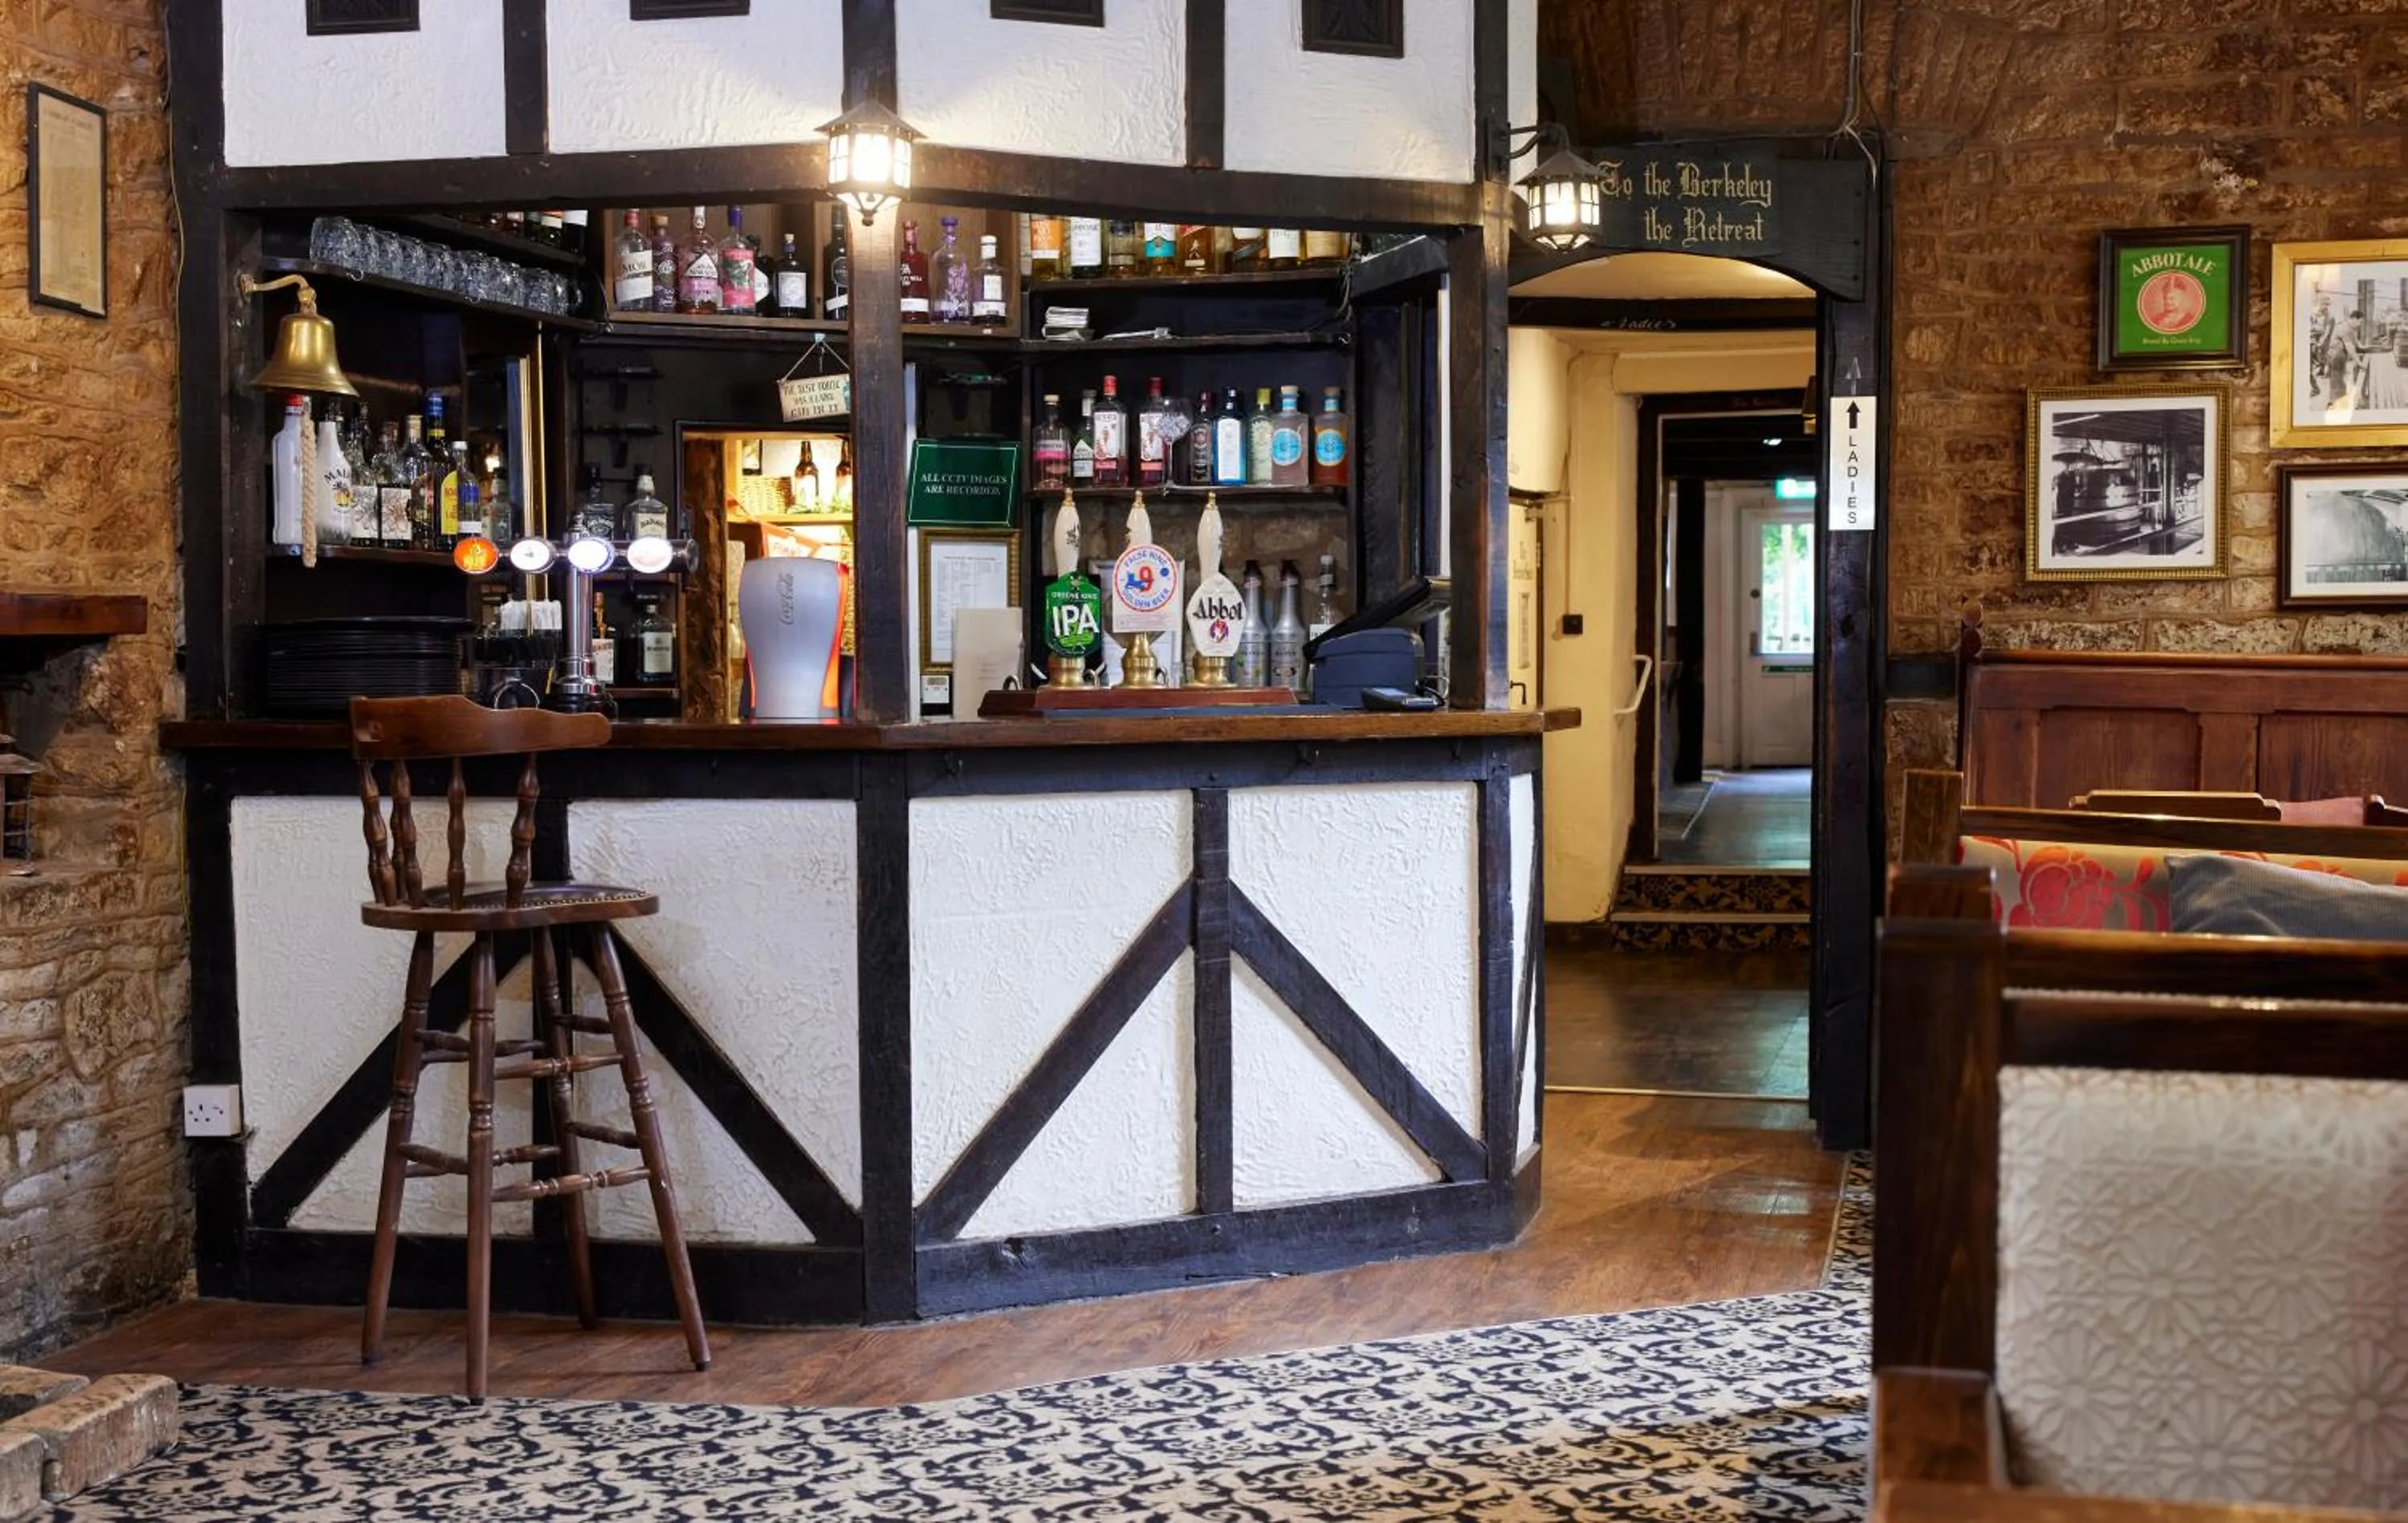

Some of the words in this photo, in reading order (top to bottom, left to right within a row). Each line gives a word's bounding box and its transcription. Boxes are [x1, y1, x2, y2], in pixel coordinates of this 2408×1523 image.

[1598, 160, 1633, 200] To
[1643, 160, 1672, 200] the
[1677, 161, 1772, 208] Berkeley
[1644, 206, 1673, 244] the
[1682, 206, 1764, 248] Retreat
[2132, 253, 2185, 278] ABBOT
[2183, 255, 2216, 276] ALE
[921, 473, 939, 482] ALL
[941, 474, 969, 484] CCTV
[970, 474, 1008, 485] IMAGES
[924, 484, 945, 494] ARE
[1847, 436, 1859, 524] LADIES
[1052, 603, 1100, 637] IPA
[1193, 596, 1243, 620] Abbot
